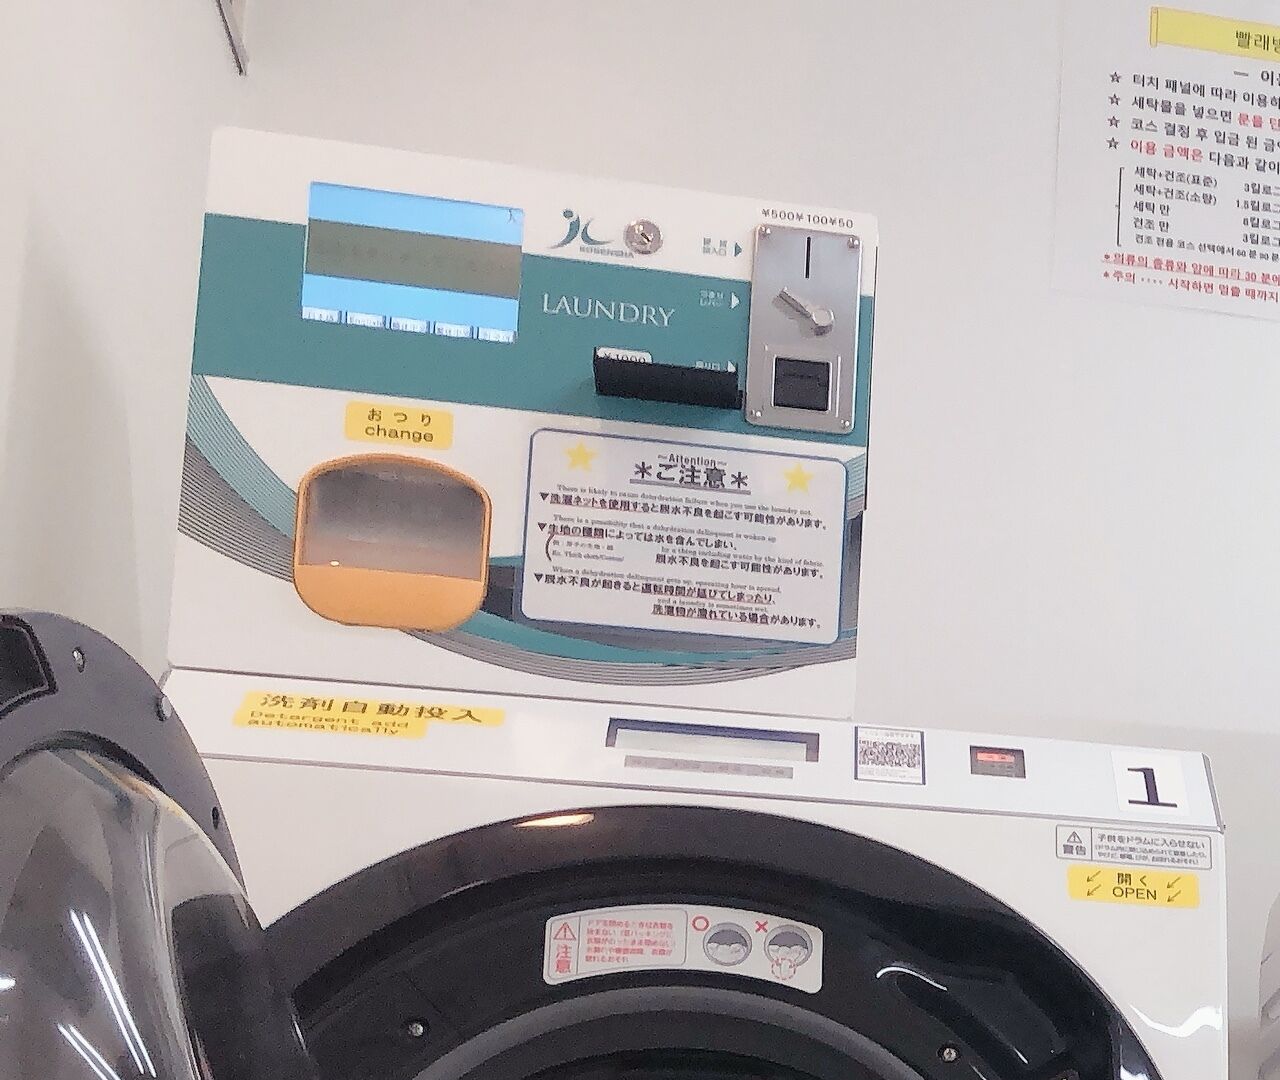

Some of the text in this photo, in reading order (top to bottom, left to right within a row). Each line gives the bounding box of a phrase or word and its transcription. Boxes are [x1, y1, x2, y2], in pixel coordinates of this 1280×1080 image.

[1211, 86, 1237, 103] 따라
[542, 292, 676, 328] LAUNDRY
[368, 408, 431, 427] おつり
[365, 425, 434, 444] change
[260, 693, 482, 724] 洗剤自動投入
[248, 719, 399, 736] automatically
[1127, 767, 1178, 808] 1
[1117, 872, 1146, 887] 開く
[1112, 886, 1157, 900] OPEN
